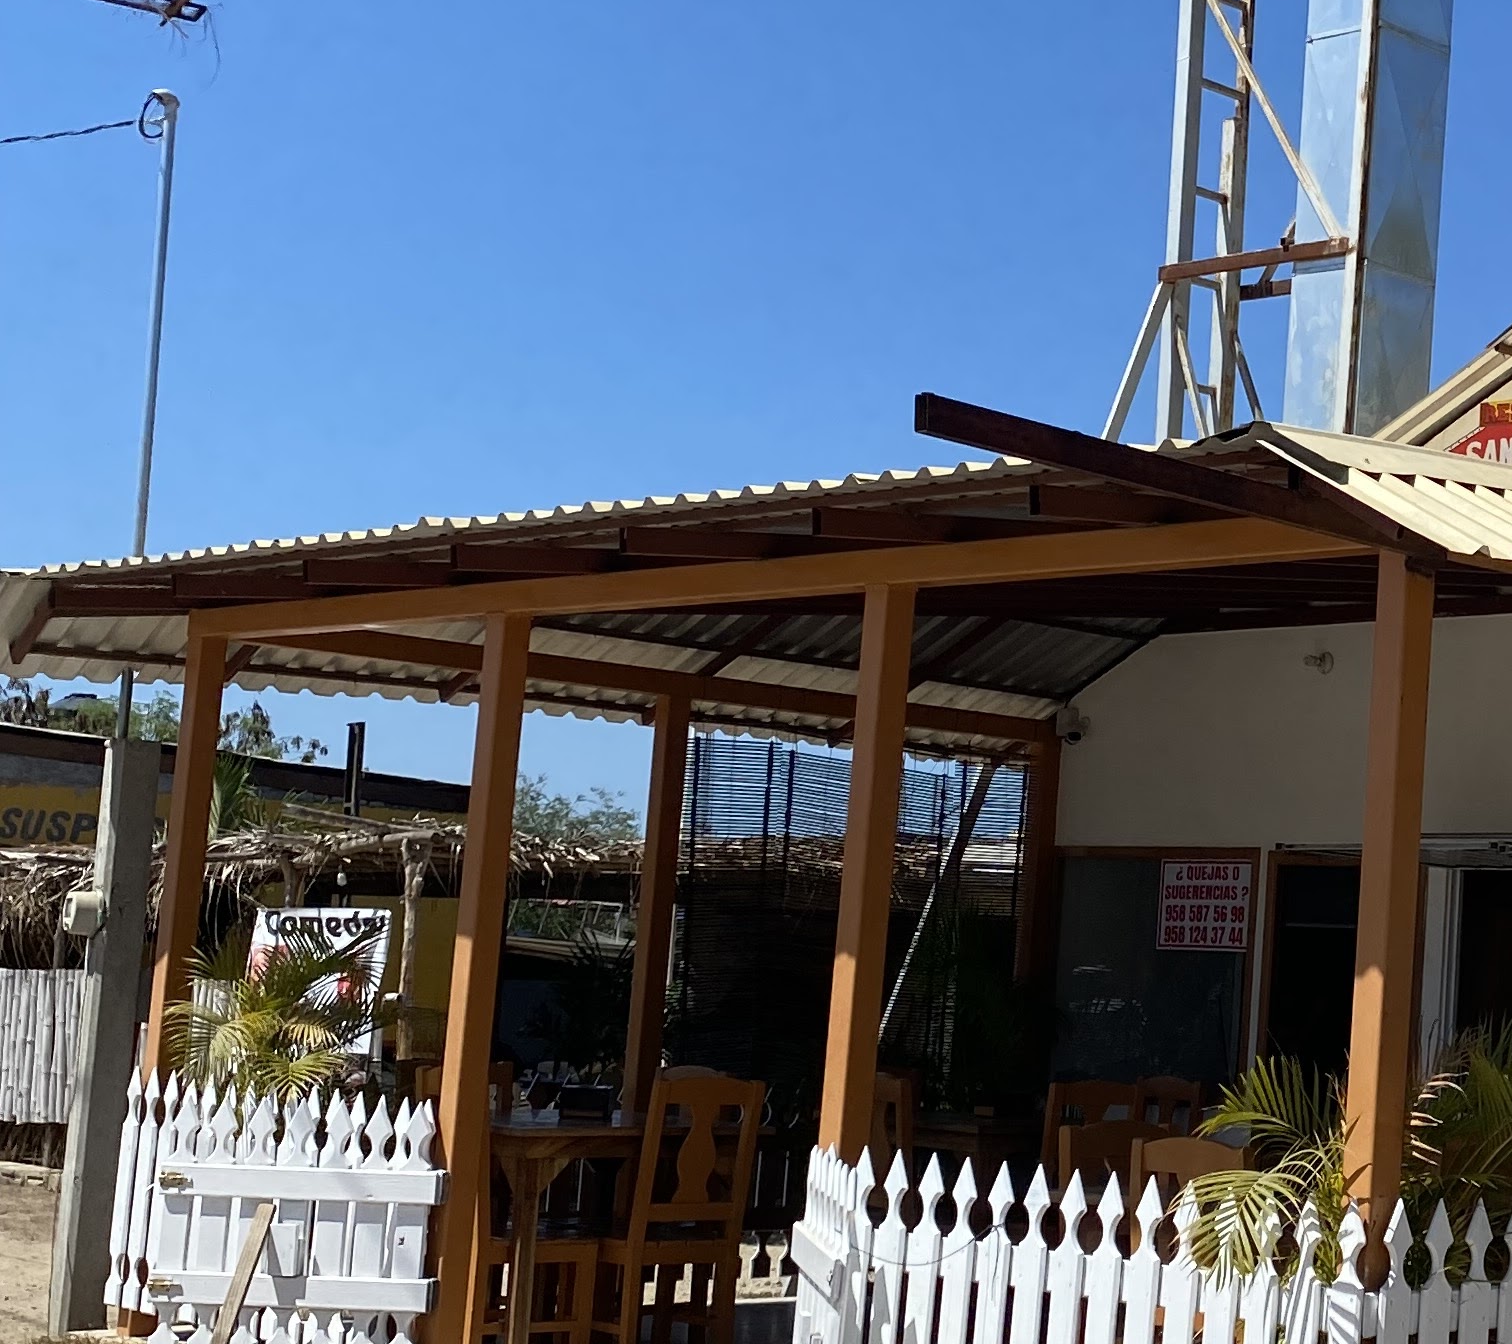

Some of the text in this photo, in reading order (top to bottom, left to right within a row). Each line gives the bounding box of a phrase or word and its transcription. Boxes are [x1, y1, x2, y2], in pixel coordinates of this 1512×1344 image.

[0, 807, 98, 844] SUSP
[1186, 865, 1229, 881] QUEJAS
[1232, 866, 1240, 881] O
[1165, 885, 1238, 901] SUGERENCIAS
[1165, 904, 1245, 923] 958 587 56 98
[1164, 925, 1244, 945] 958 124 37 44
